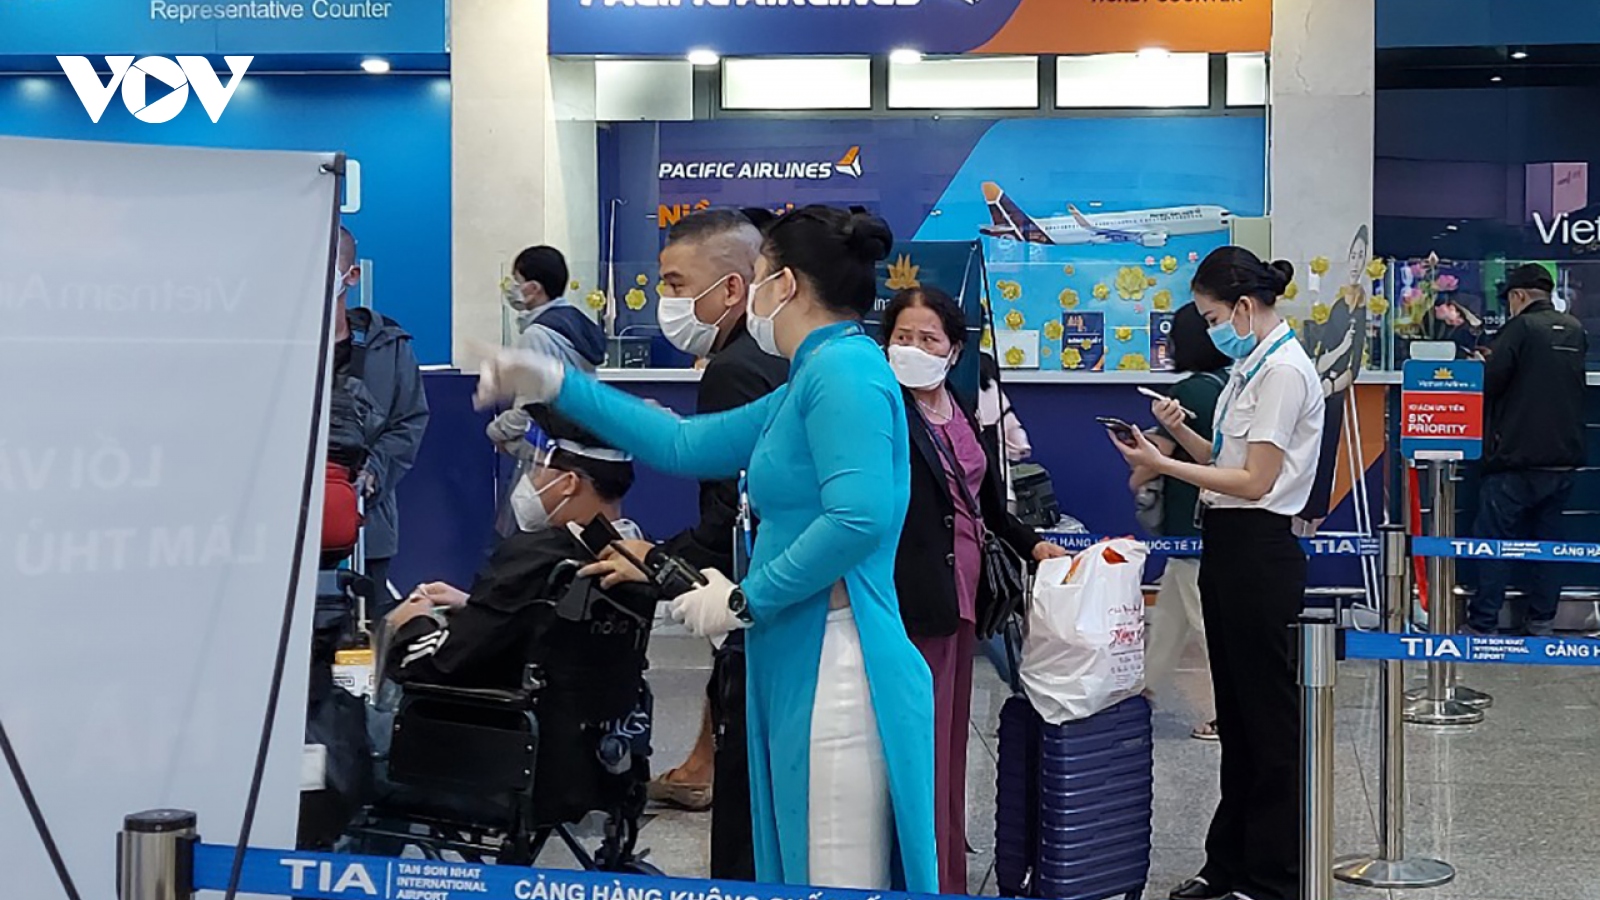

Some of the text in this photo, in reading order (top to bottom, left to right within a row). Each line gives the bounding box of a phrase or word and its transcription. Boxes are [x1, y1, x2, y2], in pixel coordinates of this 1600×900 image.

[150, 0, 392, 23] Representative Counter
[659, 163, 832, 178] PACIFIC AIRLINES
[1408, 414, 1435, 423] SKY
[1408, 424, 1467, 434] PRIORITY
[1309, 539, 1356, 554] TIA
[1450, 541, 1494, 555] TIA
[1400, 637, 1462, 657] TIA
[1545, 640, 1590, 657] CẢNG
[280, 858, 377, 895] TIA
[398, 863, 481, 879] TAN SON NHAT
[396, 876, 488, 892] INTERNATIONAL
[514, 874, 585, 900] CẢNG
[396, 888, 449, 900] AIRPORT
